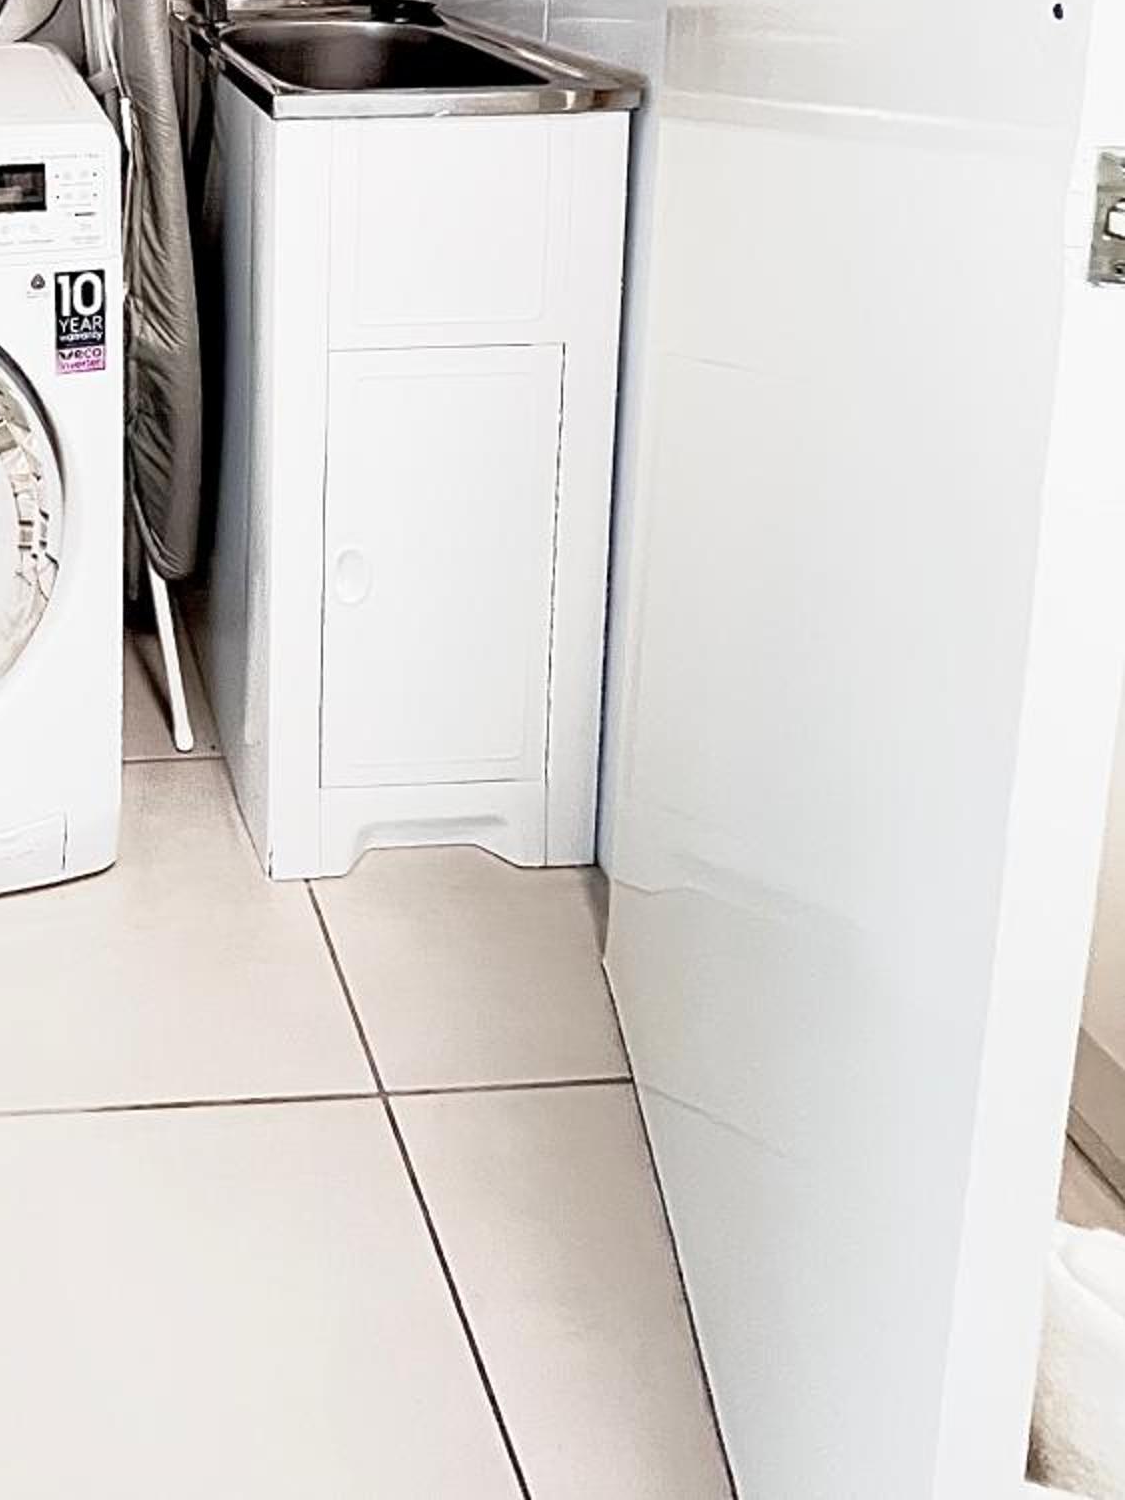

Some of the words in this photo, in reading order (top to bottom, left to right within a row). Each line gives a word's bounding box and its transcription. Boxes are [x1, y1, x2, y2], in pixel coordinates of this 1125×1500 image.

[57, 272, 103, 317] 10
[58, 315, 103, 333] YEAR
[75, 348, 102, 360] eco
